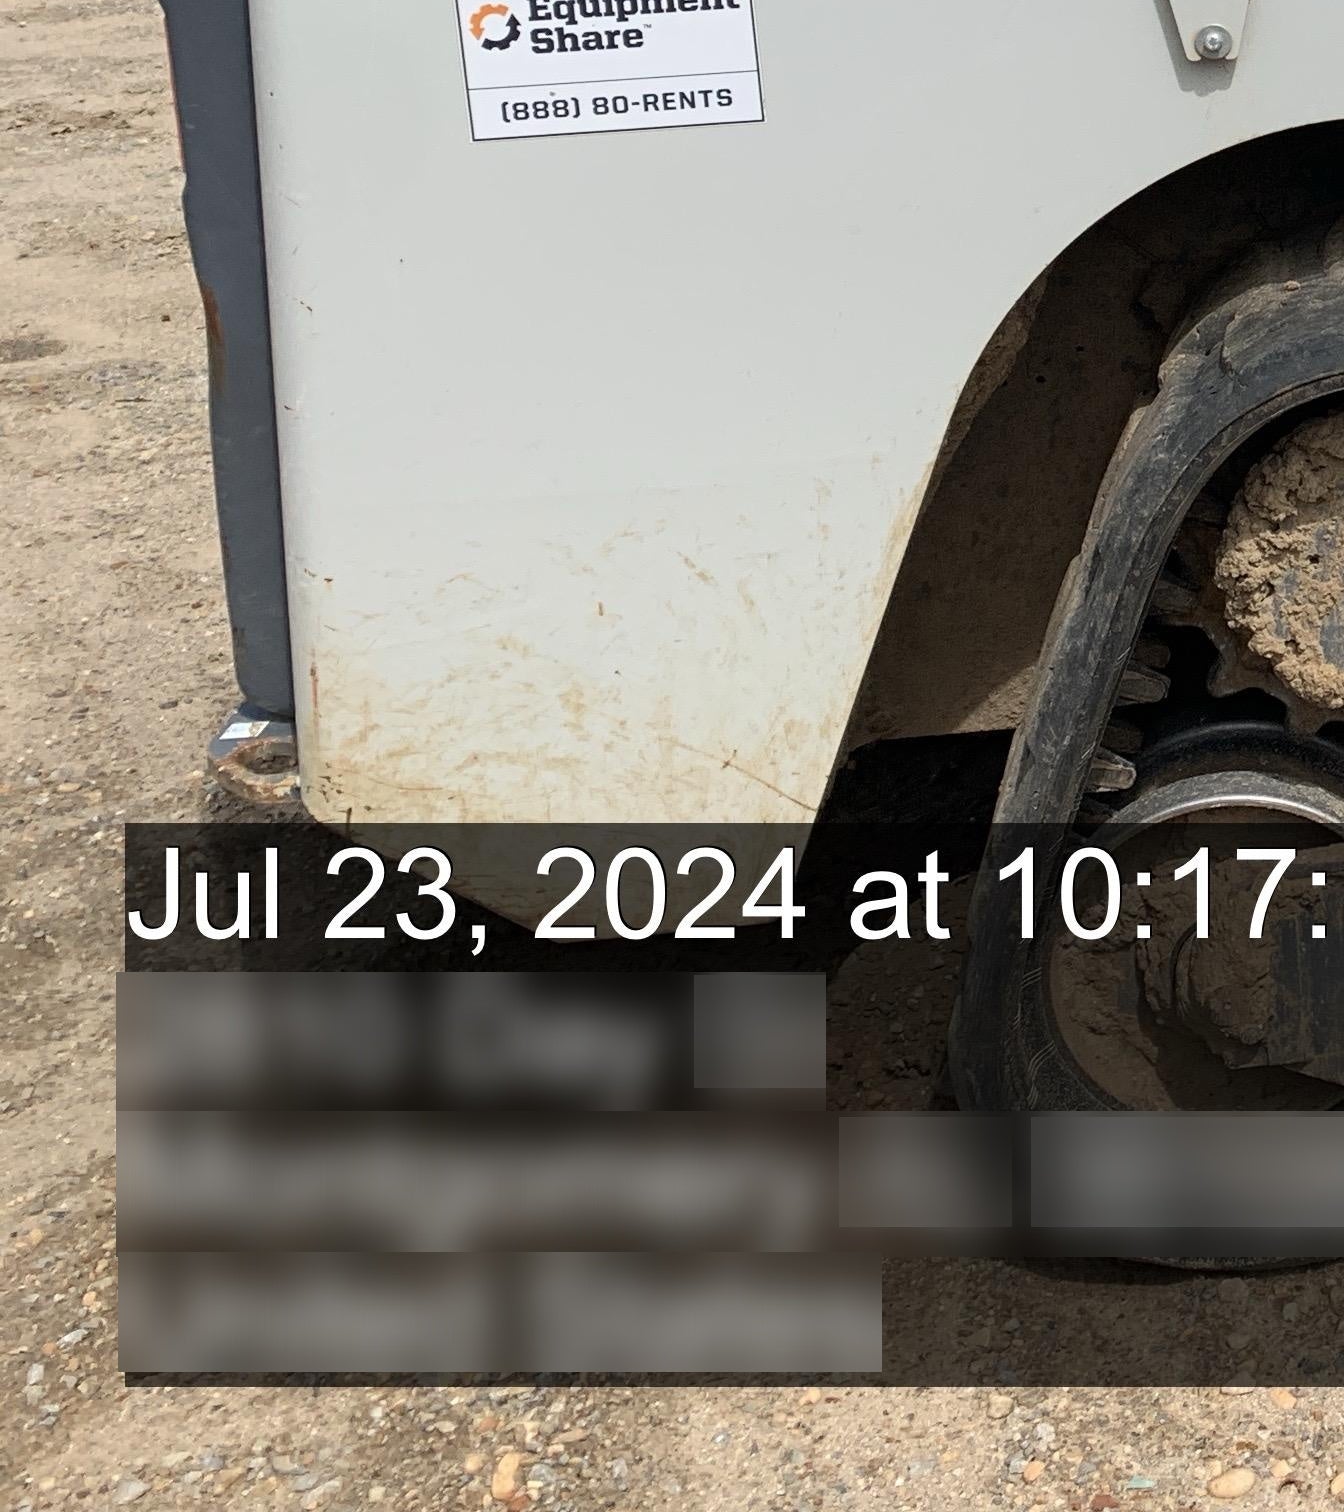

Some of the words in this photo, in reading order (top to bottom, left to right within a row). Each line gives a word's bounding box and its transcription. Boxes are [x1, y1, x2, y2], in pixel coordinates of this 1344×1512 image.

[530, 26, 645, 54] Share
[501, 97, 581, 123] (888)
[592, 88, 733, 116] 80-RENTS
